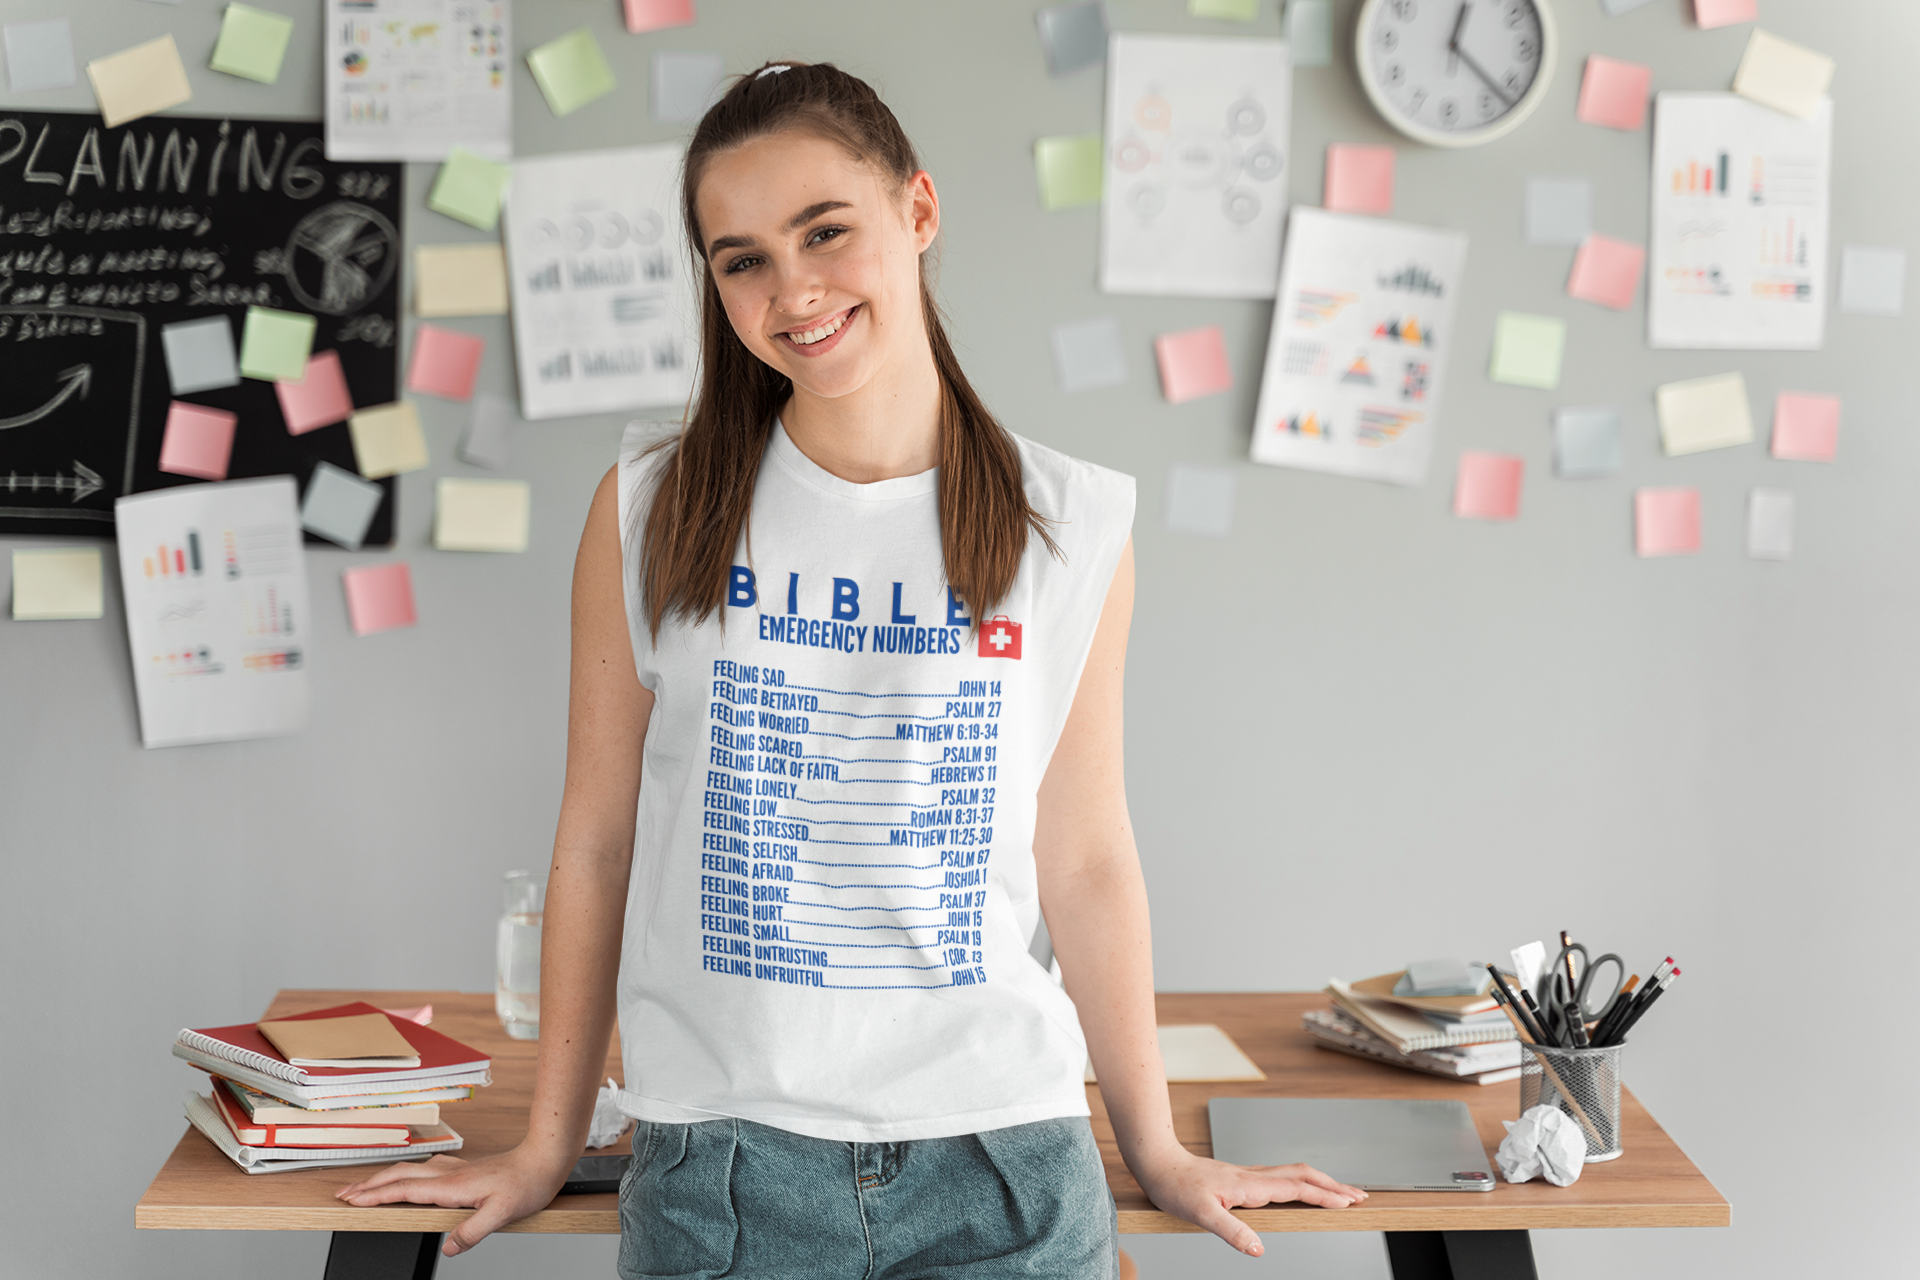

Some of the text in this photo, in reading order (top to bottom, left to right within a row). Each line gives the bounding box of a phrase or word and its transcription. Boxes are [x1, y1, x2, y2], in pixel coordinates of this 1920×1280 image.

[727, 565, 971, 627] BIBLE
[760, 614, 960, 654] EMERGENCY NUMBERS
[714, 661, 758, 683] FEELING
[990, 681, 1001, 696] 14
[713, 681, 757, 704] FEELING
[988, 702, 1001, 717] 27
[711, 703, 754, 727] FEELING
[958, 724, 998, 740] 6:19-34
[711, 726, 754, 751] FEELING
[985, 746, 996, 761] 91
[711, 746, 754, 771] FEELING
[758, 756, 786, 775] LACK
[790, 762, 804, 778] OF
[988, 766, 996, 781] 11
[707, 771, 752, 795] FEELING
[982, 788, 995, 803] 32
[705, 791, 749, 815] FEELING
[956, 807, 993, 824] 8:31-37
[704, 811, 749, 836] FEELING
[950, 827, 992, 846] 11:25-30
[704, 833, 749, 857] FEELING
[978, 849, 990, 864] 67
[702, 853, 748, 877] FEELING
[982, 868, 987, 884] 1
[702, 875, 748, 898] FEELING
[975, 891, 986, 907] 37
[702, 894, 748, 917] FEELING
[973, 911, 982, 926] 15
[702, 914, 749, 936] FEELING
[972, 931, 981, 946] 19
[703, 935, 750, 957] FEELING
[949, 948, 969, 966] COR.
[971, 950, 983, 963] 13
[704, 955, 751, 977] FEELING
[974, 966, 987, 983] 15
